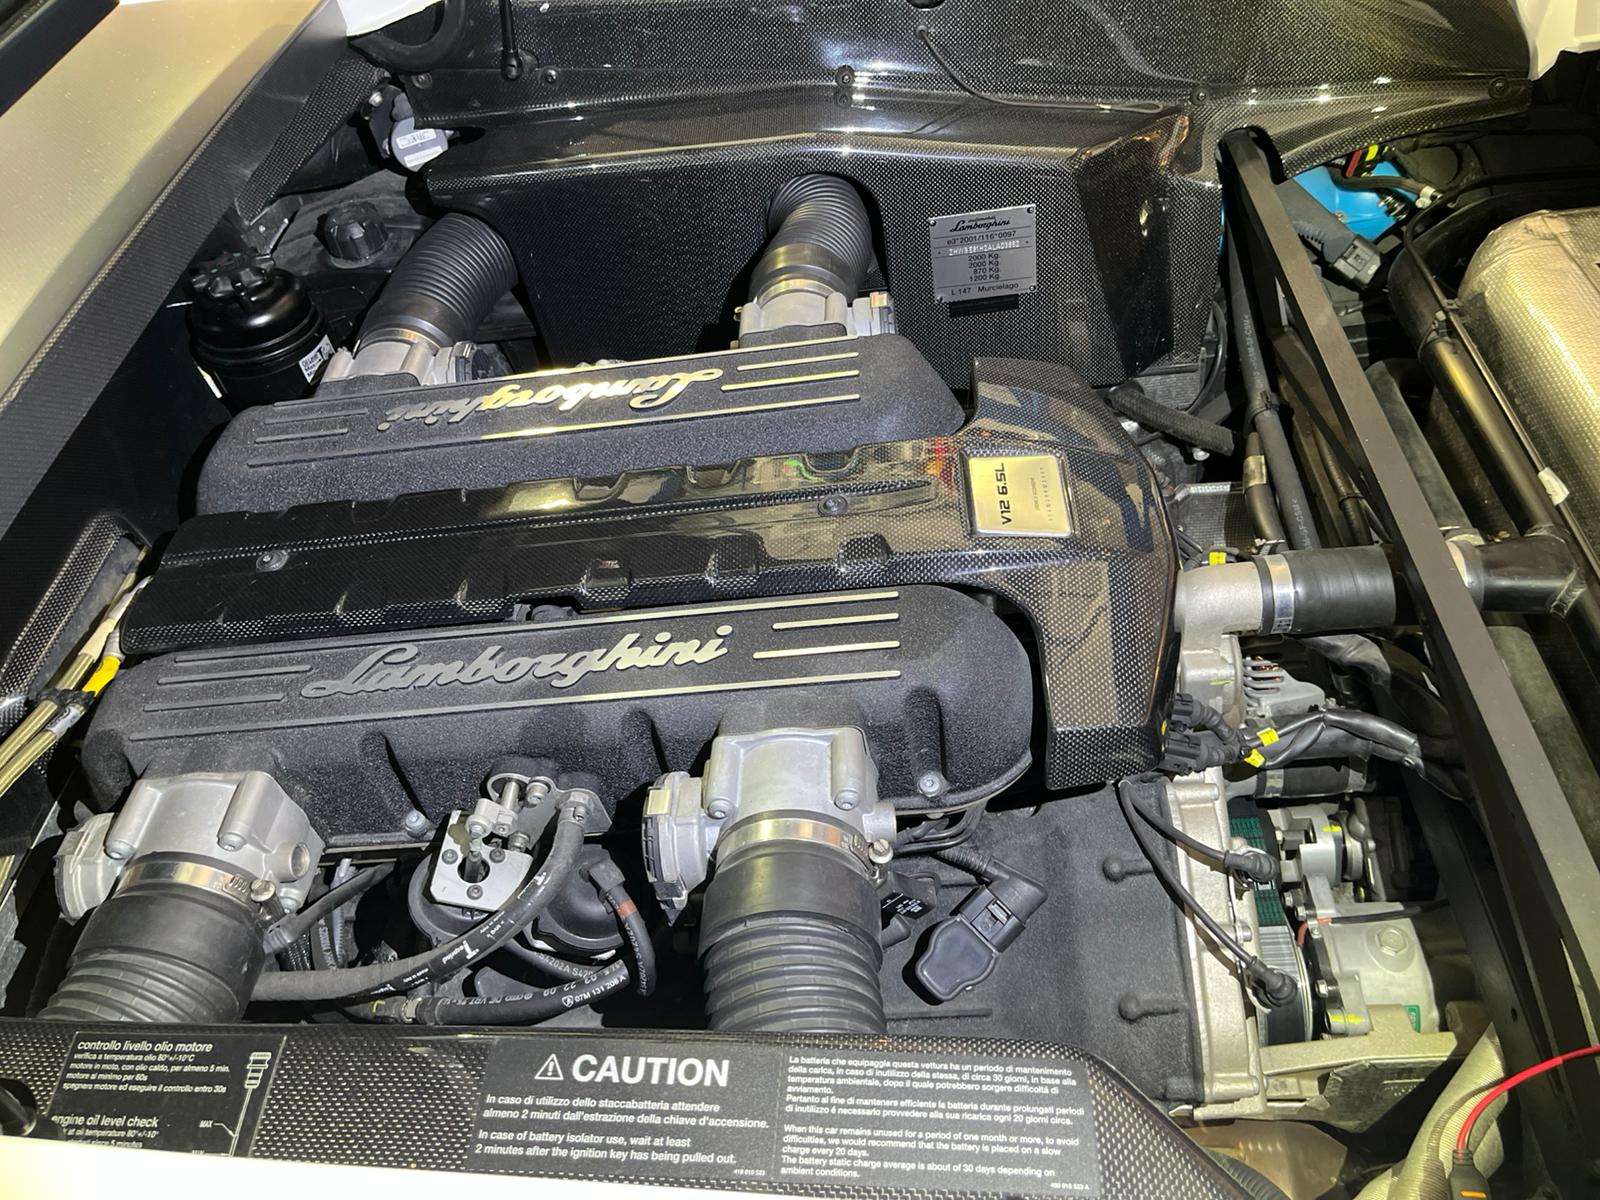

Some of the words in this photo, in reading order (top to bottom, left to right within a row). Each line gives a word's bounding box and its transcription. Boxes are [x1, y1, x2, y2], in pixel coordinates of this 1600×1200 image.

[949, 217, 1011, 232] Lamborghini
[978, 282, 1019, 292] Murcielago
[377, 368, 724, 431] Lamborghini
[994, 462, 1008, 495] 6.5L
[999, 500, 1013, 525] V12
[300, 625, 733, 699] Lamborghini
[592, 986, 605, 996] 131
[77, 1040, 121, 1050] controllo
[122, 1040, 152, 1051] livello
[153, 1041, 173, 1051] olio
[174, 1041, 212, 1052] motore
[572, 1053, 730, 1087] CAUTION
[486, 1094, 495, 1103] In
[497, 1096, 521, 1104] caso
[523, 1095, 534, 1104] di
[535, 1095, 570, 1106] utilizzo
[571, 1097, 596, 1107] dello
[598, 1098, 669, 1110] staccabatteria
[670, 1101, 720, 1112] attendere
[86, 1114, 100, 1125] oil
[100, 1115, 126, 1126] level
[126, 1116, 159, 1127] check
[199, 1120, 213, 1128] MAX
[482, 1108, 519, 1118] almeno
[521, 1109, 528, 1118] 2
[529, 1110, 560, 1119] minuti
[562, 1111, 635, 1122] dall'estrazione
[636, 1113, 661, 1123] della
[663, 1115, 696, 1125] chiave
[698, 1116, 769, 1128] d'accensione.
[478, 1129, 488, 1138] In
[489, 1131, 514, 1140] case
[516, 1131, 527, 1140] of
[528, 1131, 564, 1144] battery
[566, 1133, 604, 1143] isolator
[605, 1136, 627, 1145] use,
[629, 1135, 651, 1145] wait
[652, 1136, 664, 1146] at
[665, 1136, 691, 1147] least
[783, 1124, 806, 1132] When
[808, 1125, 823, 1133] this
[873, 1129, 902, 1137] unused
[924, 1131, 951, 1139] period
[952, 1132, 961, 1140] of
[1019, 1136, 1043, 1145] more,
[1045, 1136, 1054, 1144] to
[1055, 1137, 1079, 1145] avoid
[474, 1144, 482, 1153] 2
[483, 1145, 523, 1154] minutes
[525, 1146, 550, 1155] after
[551, 1147, 568, 1156] the
[569, 1147, 607, 1159] ignition
[609, 1149, 628, 1161] key
[629, 1150, 648, 1160] has
[650, 1151, 680, 1163] being
[681, 1152, 714, 1163] pulled
[715, 1153, 736, 1164] out.
[781, 1145, 810, 1155] charge
[811, 1147, 834, 1156] every
[835, 1147, 846, 1155] 20
[847, 1148, 869, 1158] days.
[782, 1135, 826, 1144] difficulties,
[867, 1139, 916, 1148] recommend
[951, 1142, 980, 1153] battery
[991, 1144, 1019, 1153] placed
[1041, 1147, 1061, 1155] slow
[780, 1166, 813, 1175] ambient
[815, 1168, 860, 1177] conditions.
[781, 1155, 796, 1163] The
[798, 1156, 827, 1166] battery
[828, 1158, 851, 1166] static
[852, 1159, 881, 1169] charge
[882, 1161, 915, 1171] average
[926, 1162, 950, 1171] about
[962, 1164, 973, 1172] 30
[975, 1165, 995, 1175] days
[996, 1166, 1042, 1177] depending
